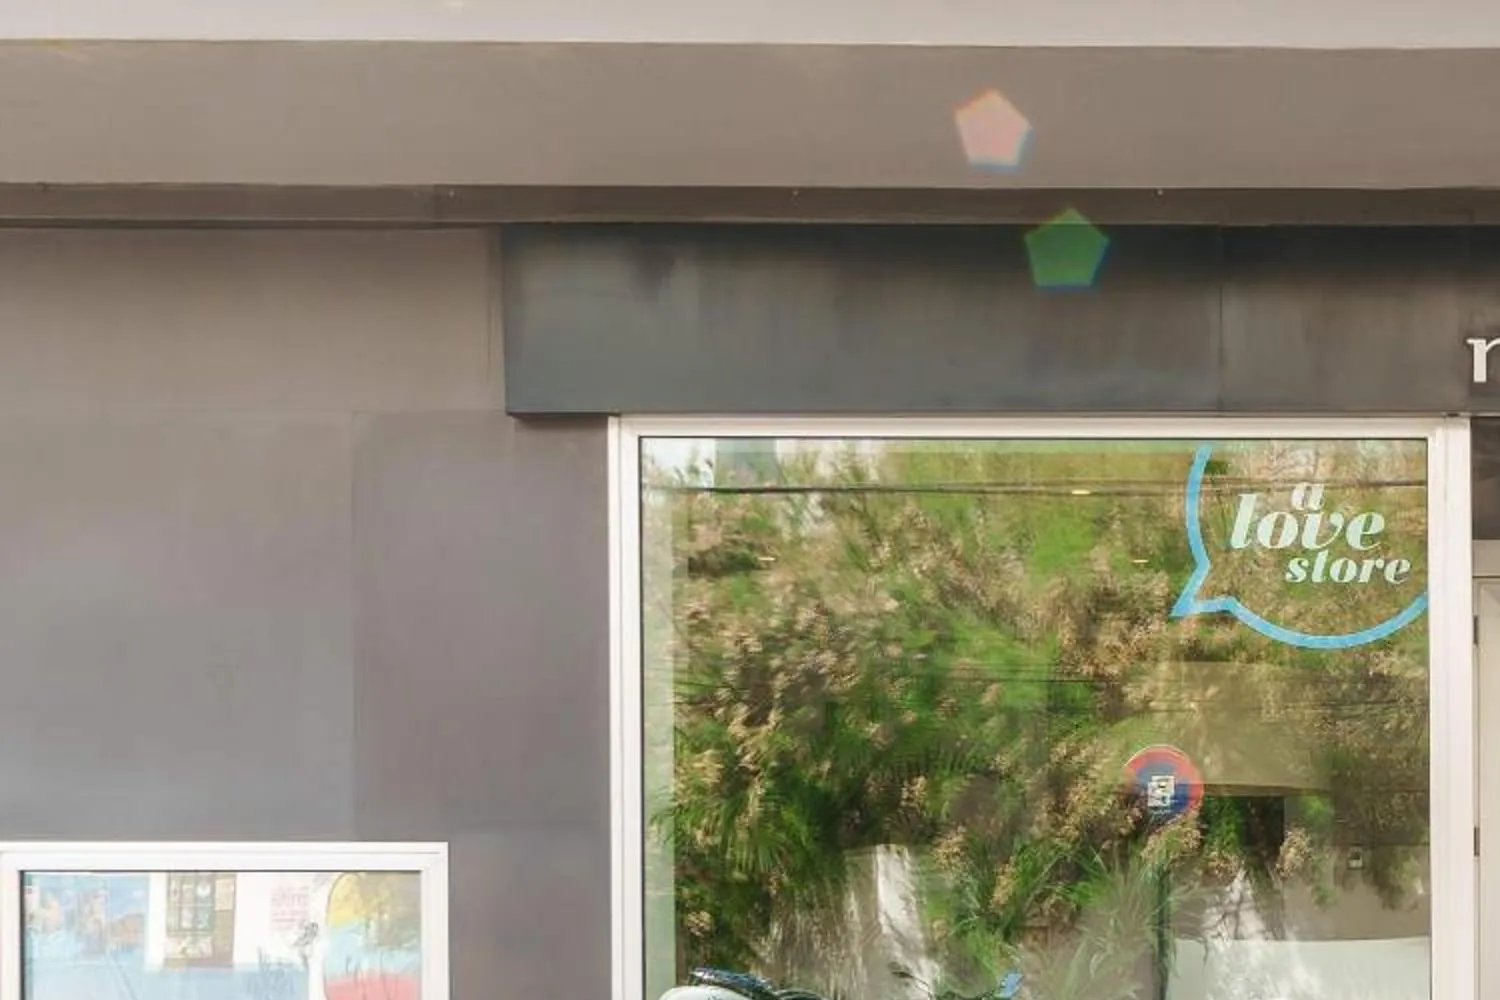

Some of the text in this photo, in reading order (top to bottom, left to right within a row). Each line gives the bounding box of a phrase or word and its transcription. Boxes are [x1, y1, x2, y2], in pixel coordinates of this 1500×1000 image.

[1291, 481, 1326, 511] a
[1229, 493, 1386, 550] love
[1284, 550, 1412, 585] store
